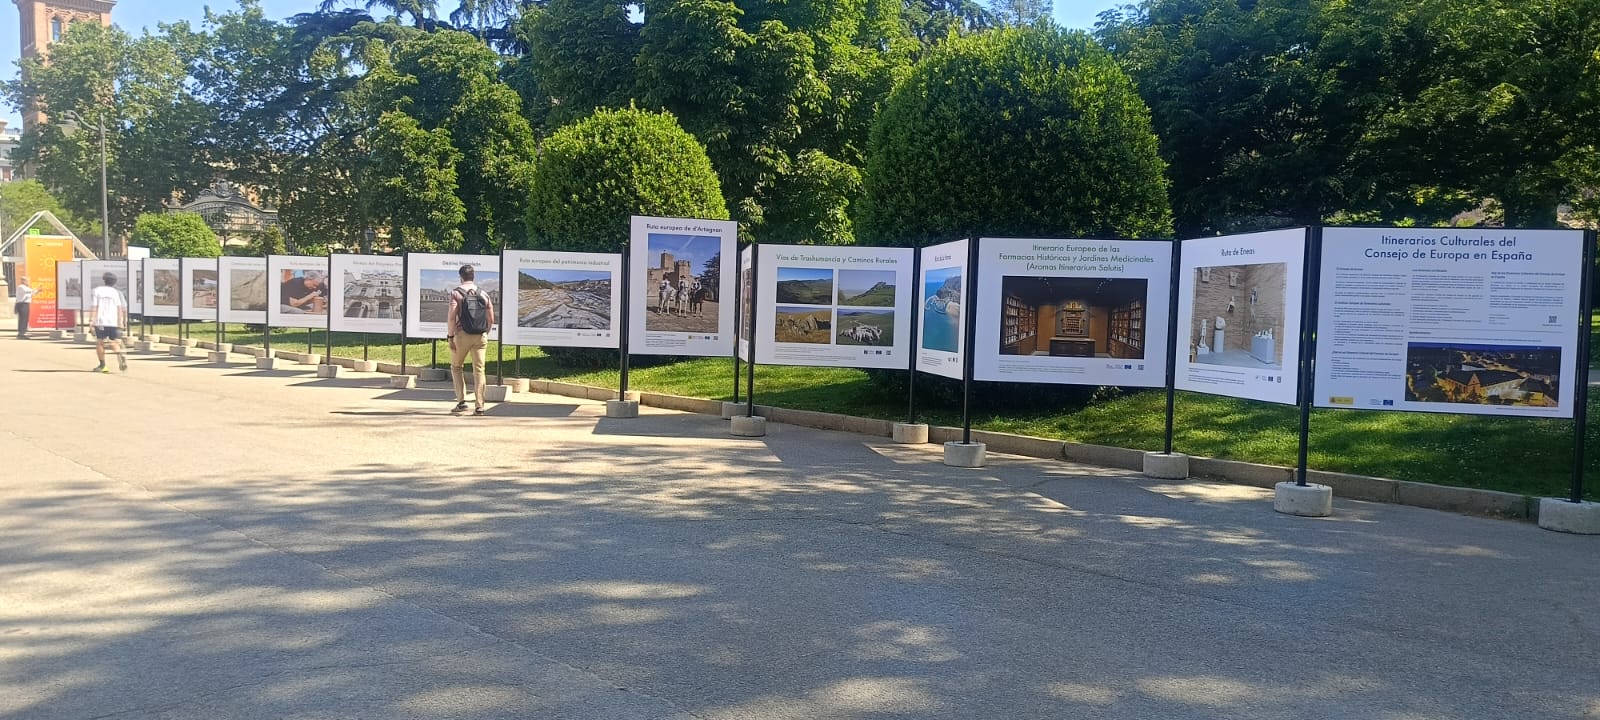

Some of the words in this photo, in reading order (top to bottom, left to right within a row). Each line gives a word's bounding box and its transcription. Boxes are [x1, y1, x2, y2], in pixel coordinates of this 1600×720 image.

[1381, 235, 1436, 246] Itinerarios
[1440, 236, 1495, 246] Culturales
[1499, 236, 1516, 247] del
[1066, 245, 1096, 253] Europeo
[1110, 245, 1120, 253] las
[1036, 253, 1070, 262] Históricas
[1078, 254, 1108, 262] Jardines
[1110, 255, 1154, 263] Medicinales
[1364, 248, 1408, 260] Consejo
[1412, 248, 1426, 258] de
[1430, 250, 1470, 262] Europa
[1473, 252, 1487, 260] en
[1491, 250, 1532, 262] España
[1026, 262, 1057, 270] (Aromas
[1058, 262, 1096, 271] Itinerarium
[1099, 264, 1124, 272] Salutis)
